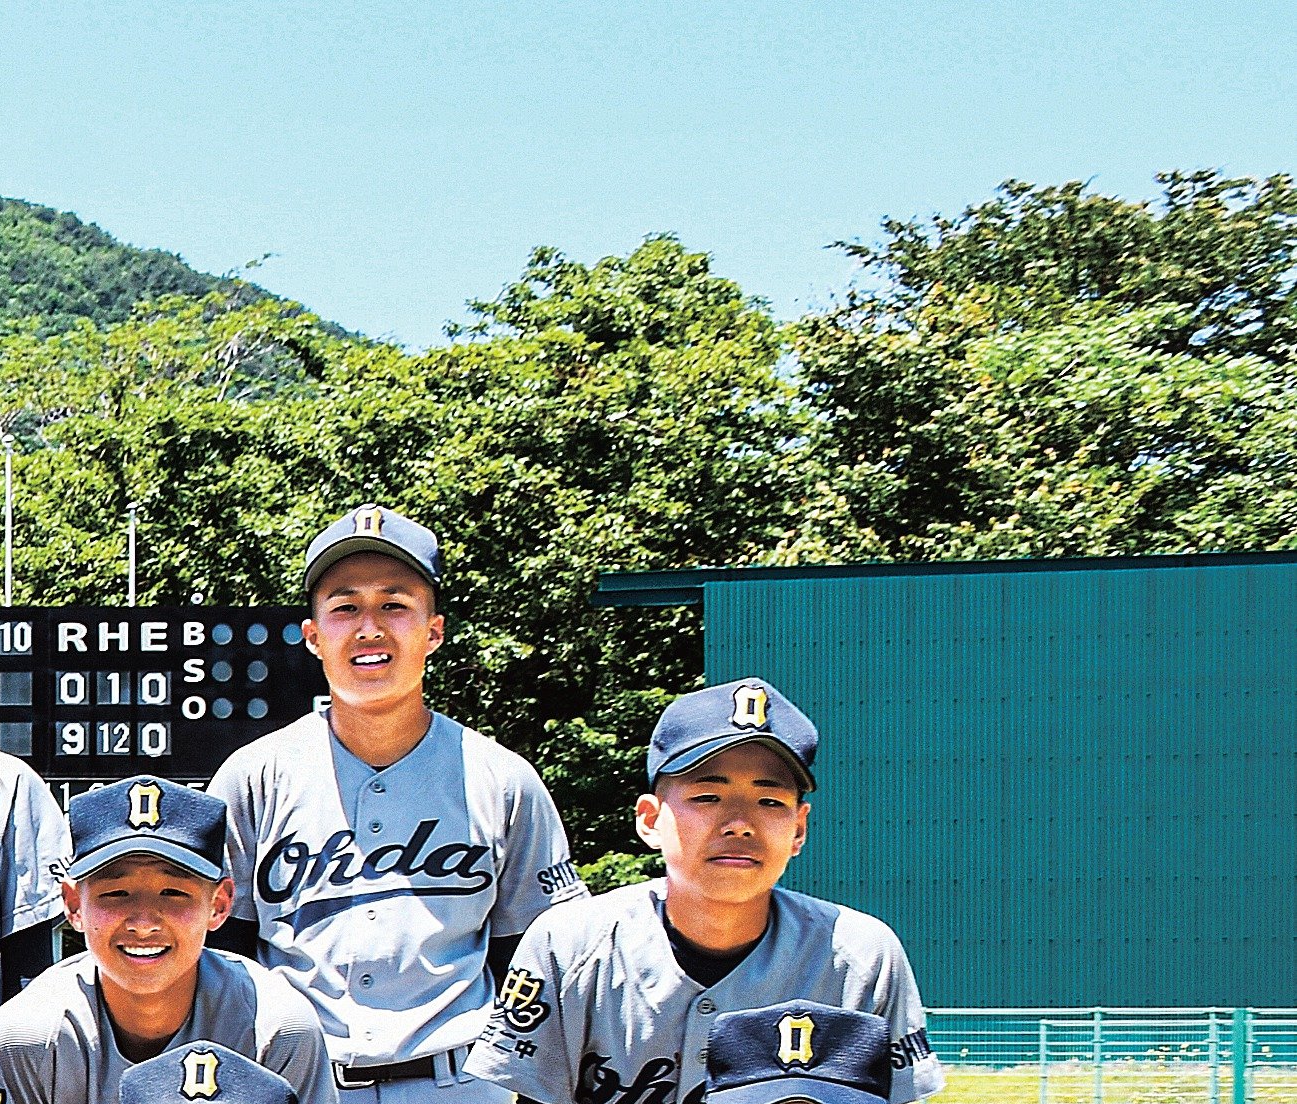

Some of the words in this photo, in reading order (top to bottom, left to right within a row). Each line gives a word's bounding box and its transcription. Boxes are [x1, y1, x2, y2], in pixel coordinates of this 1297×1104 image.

[0, 622, 32, 652] 10
[58, 622, 87, 652] R
[98, 622, 129, 652] H
[141, 622, 168, 652] E
[183, 622, 205, 646] B
[183, 658, 205, 683] S
[59, 672, 85, 704] 0
[107, 672, 120, 704] 1
[141, 672, 167, 704] 0
[181, 695, 206, 720] O
[61, 722, 85, 754] 9
[98, 722, 130, 754] 12
[141, 722, 167, 756] 0
[257, 819, 493, 903] Ohda
